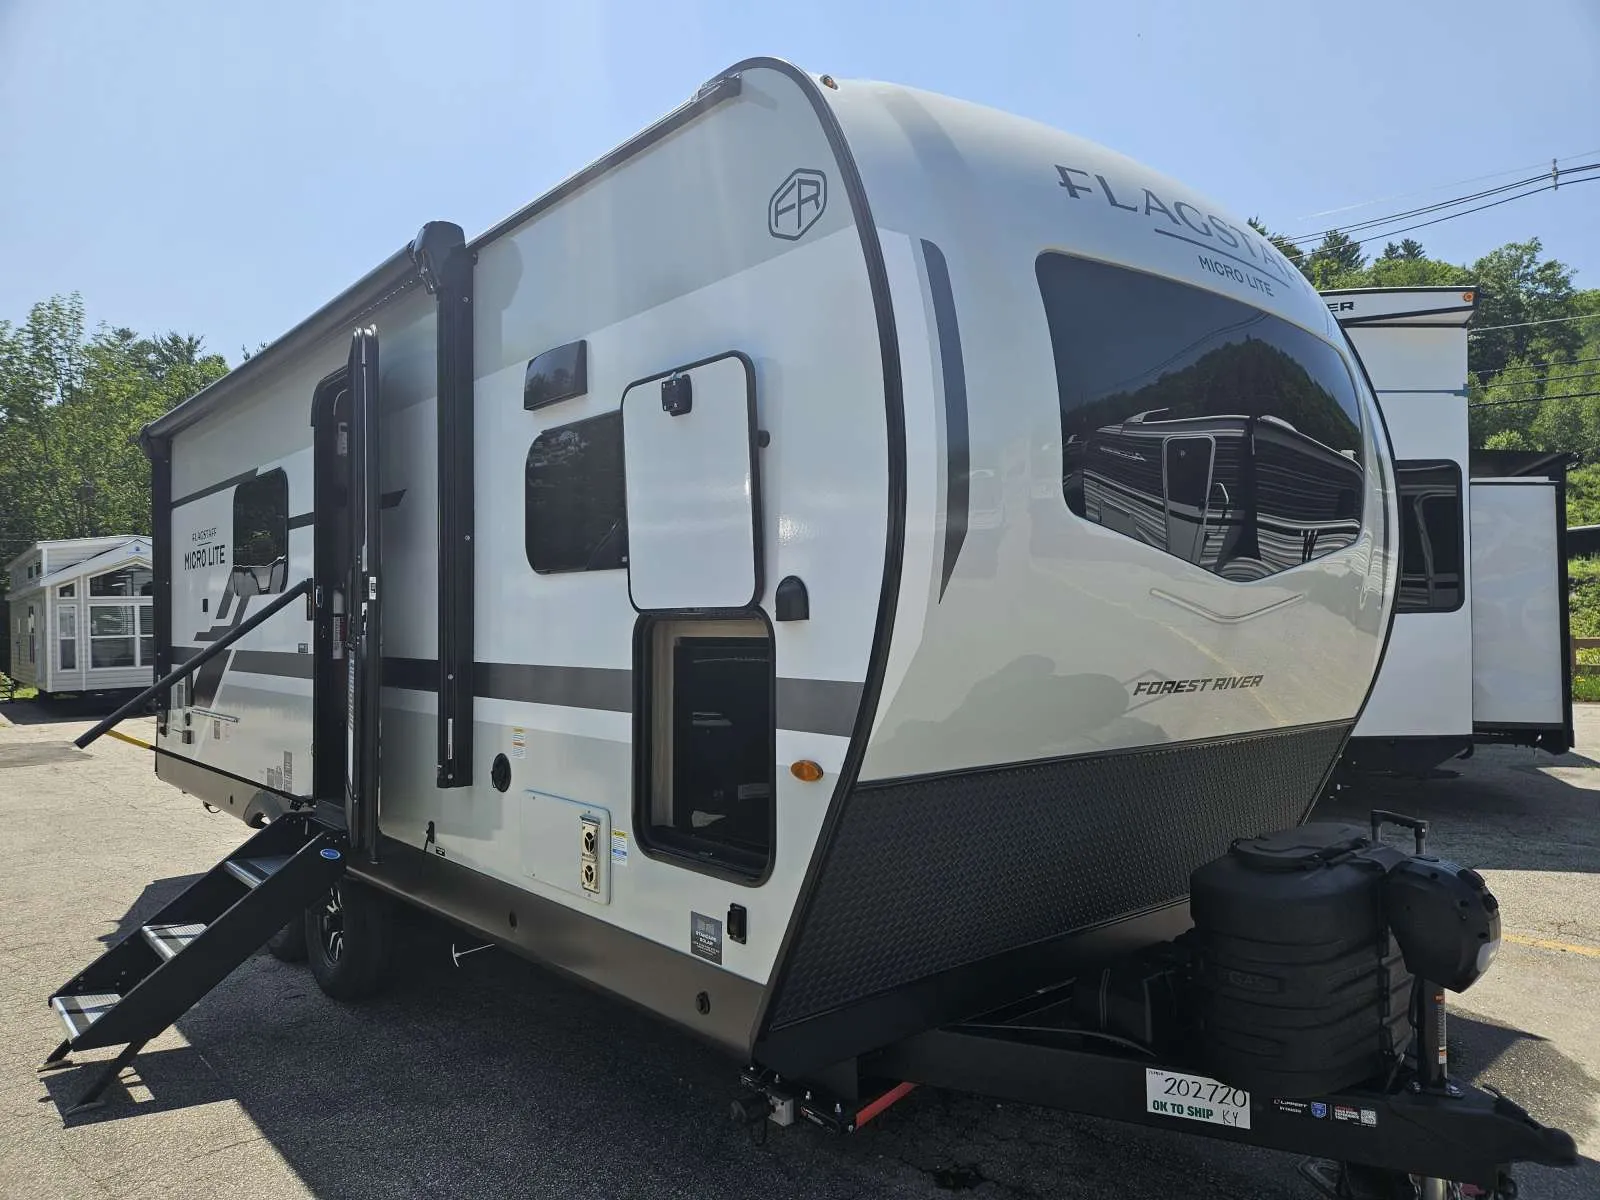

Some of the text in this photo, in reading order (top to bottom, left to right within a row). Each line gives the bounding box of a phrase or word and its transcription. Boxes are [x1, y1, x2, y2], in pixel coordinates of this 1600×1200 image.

[1054, 164, 1312, 297] FLAGSTAF
[1198, 255, 1275, 297] MICRO LITE
[191, 527, 218, 542] FLAGSTAFF
[184, 544, 226, 570] MICRO LITE
[1133, 674, 1264, 696] FOREST RIVER
[1164, 1077, 1247, 1108] 202720
[1152, 1099, 1214, 1119] OK TO SHIP
